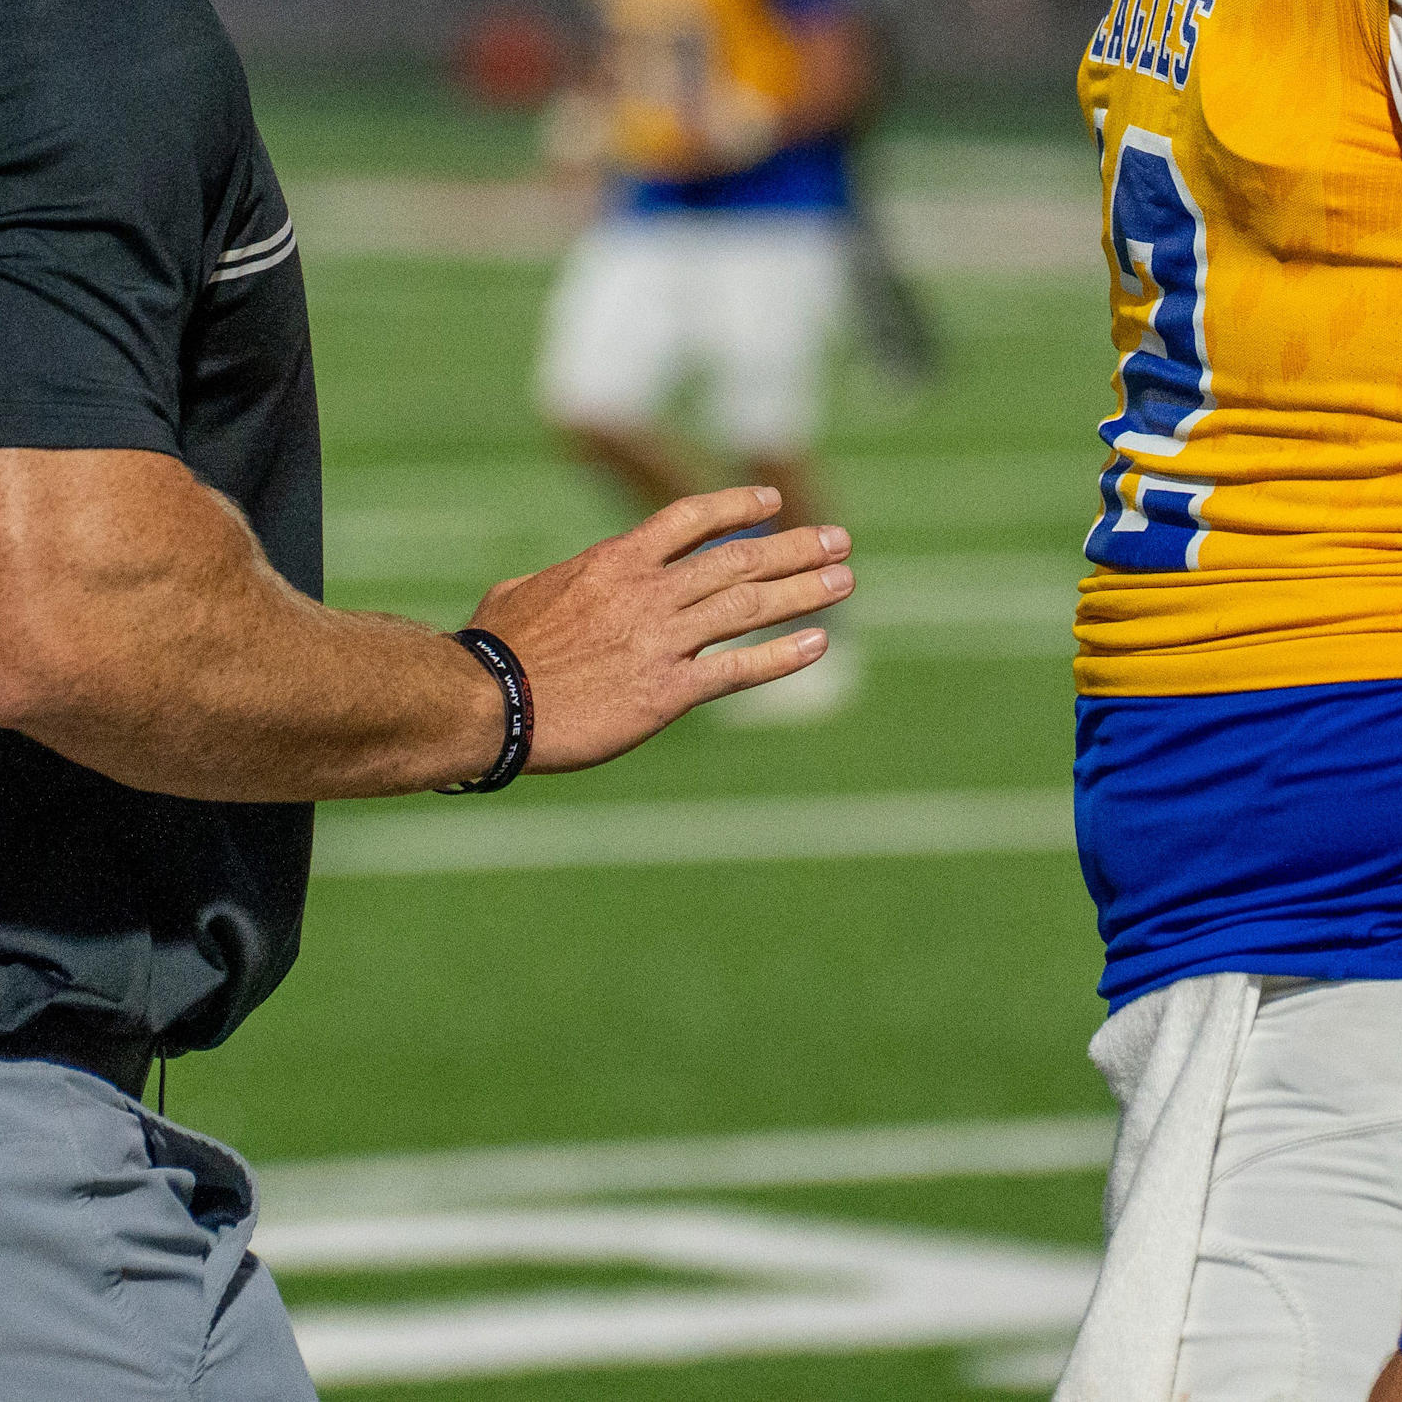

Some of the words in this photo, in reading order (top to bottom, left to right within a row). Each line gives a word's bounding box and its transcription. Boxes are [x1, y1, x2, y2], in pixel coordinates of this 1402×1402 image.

[1083, 108, 1216, 573] 2
[477, 641, 506, 670] WHAT
[504, 675, 520, 707] WHY
[512, 715, 521, 736] LIE
